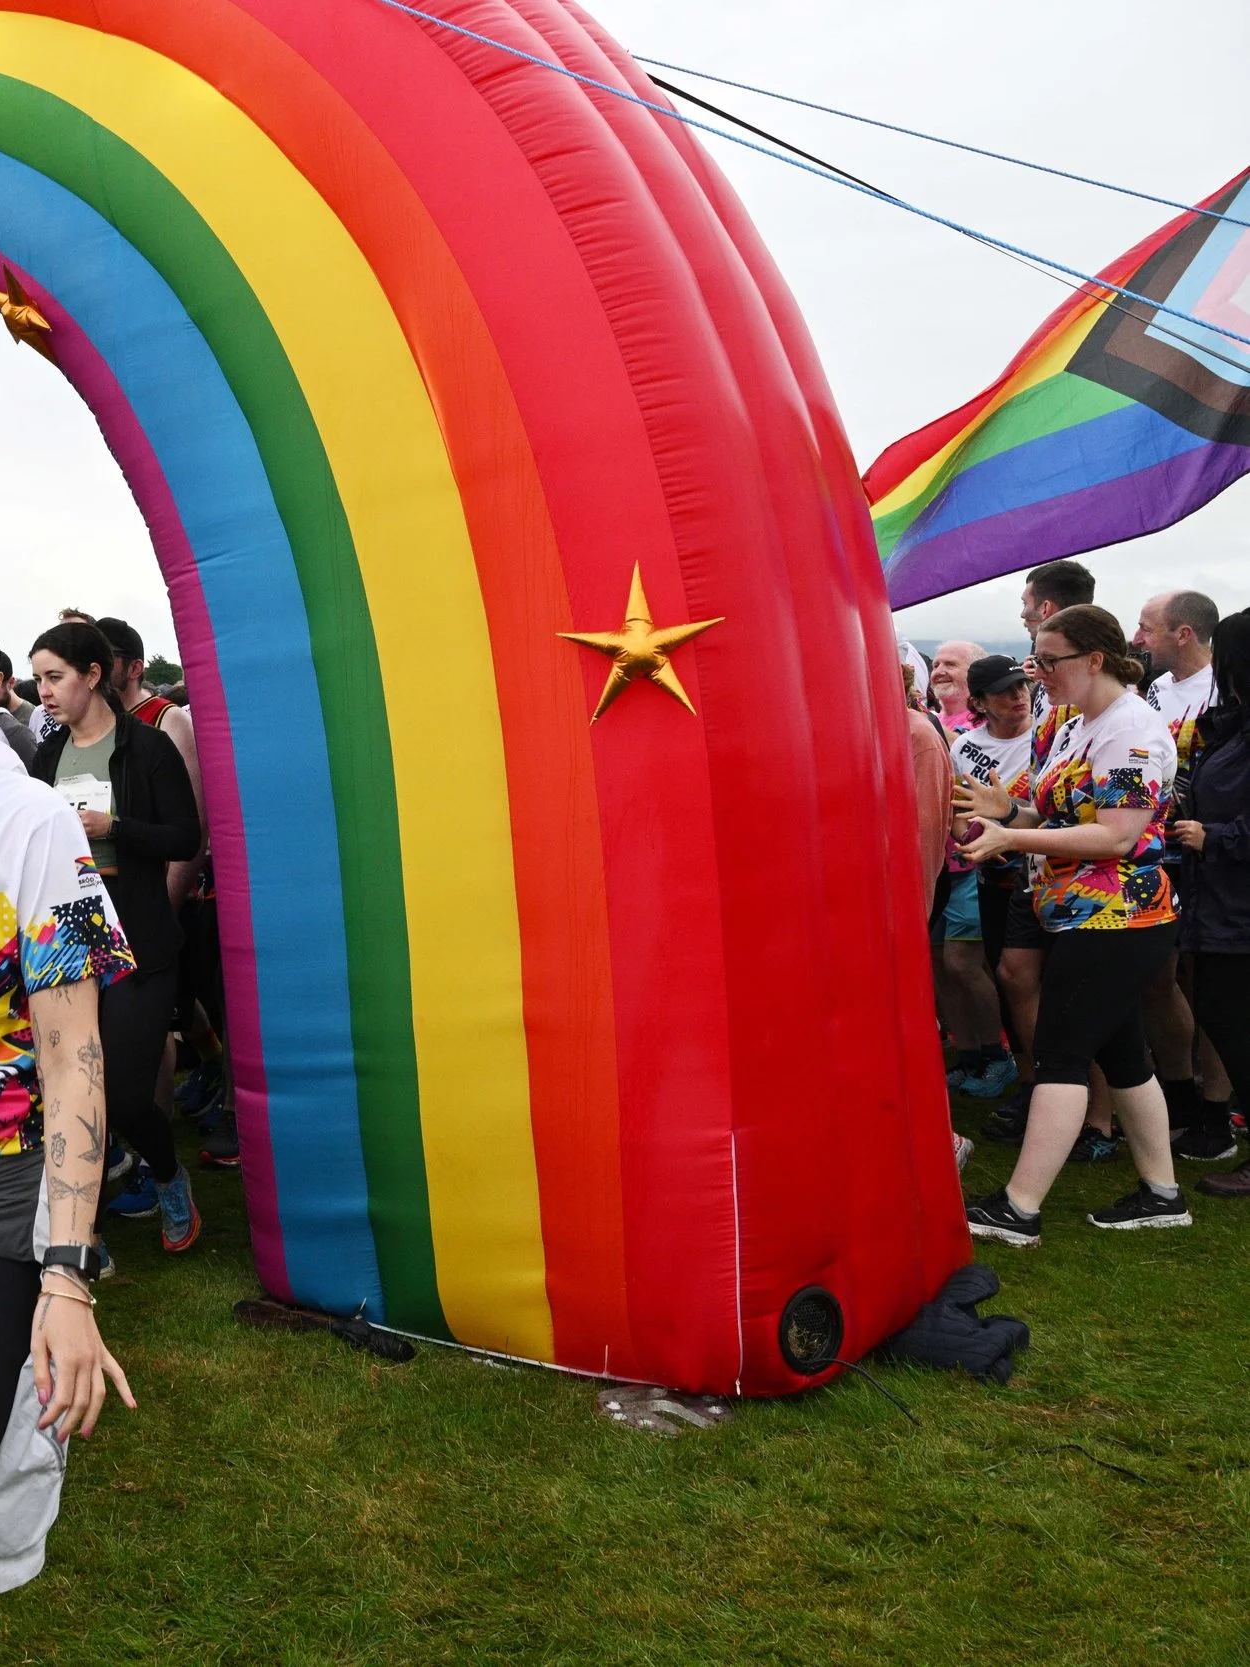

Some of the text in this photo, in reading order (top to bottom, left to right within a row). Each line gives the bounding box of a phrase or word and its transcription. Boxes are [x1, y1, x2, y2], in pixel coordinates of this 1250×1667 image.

[39, 723, 52, 740] RU
[959, 743, 1001, 771] PRIDE
[1066, 881, 1116, 903] RUN
